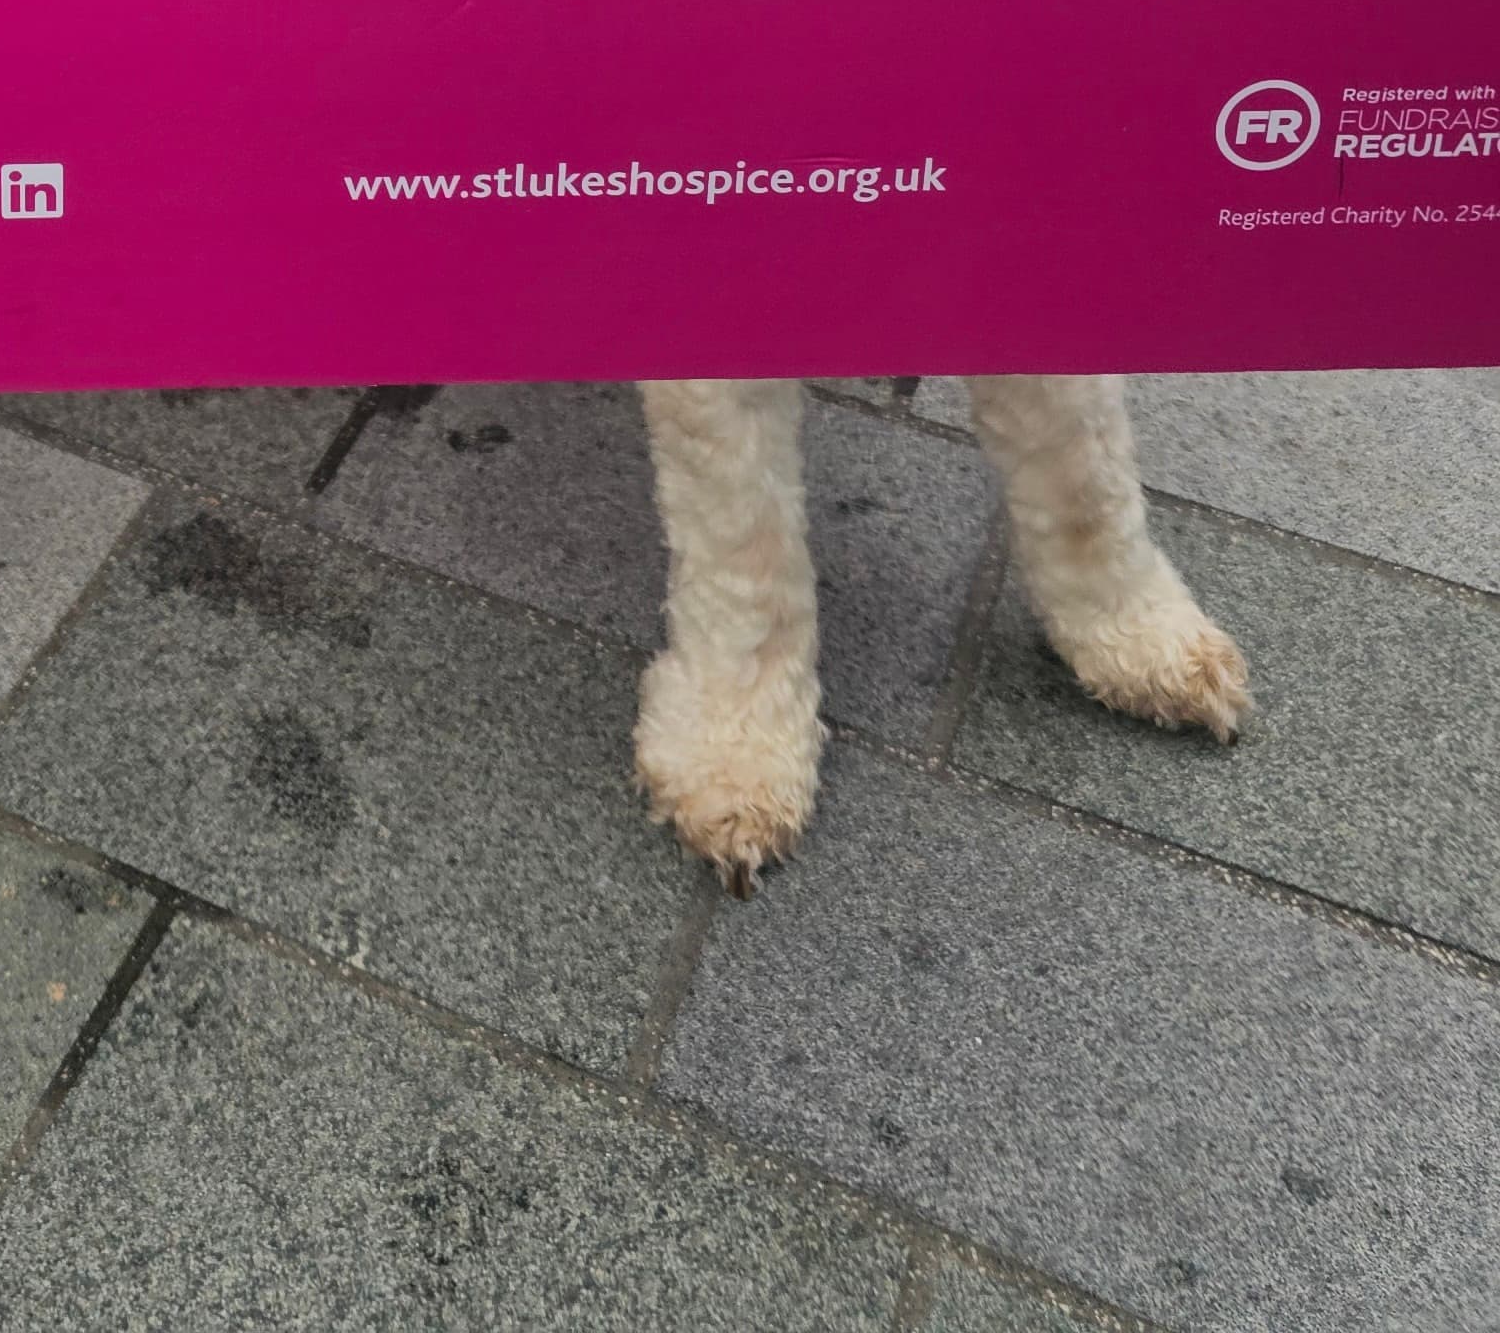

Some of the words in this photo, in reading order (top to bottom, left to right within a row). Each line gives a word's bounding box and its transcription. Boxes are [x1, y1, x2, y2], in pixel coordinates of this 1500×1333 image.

[1342, 86, 1448, 104] Registered
[1455, 84, 1496, 101] with
[1235, 109, 1303, 145] FR
[1333, 132, 1500, 159] REGULAT
[343, 158, 947, 204] www.stlukeshospice.org.uk
[1218, 207, 1325, 230] Registered
[1330, 205, 1406, 228] Charity
[1412, 205, 1449, 223] No.
[1455, 204, 1500, 222] 254
